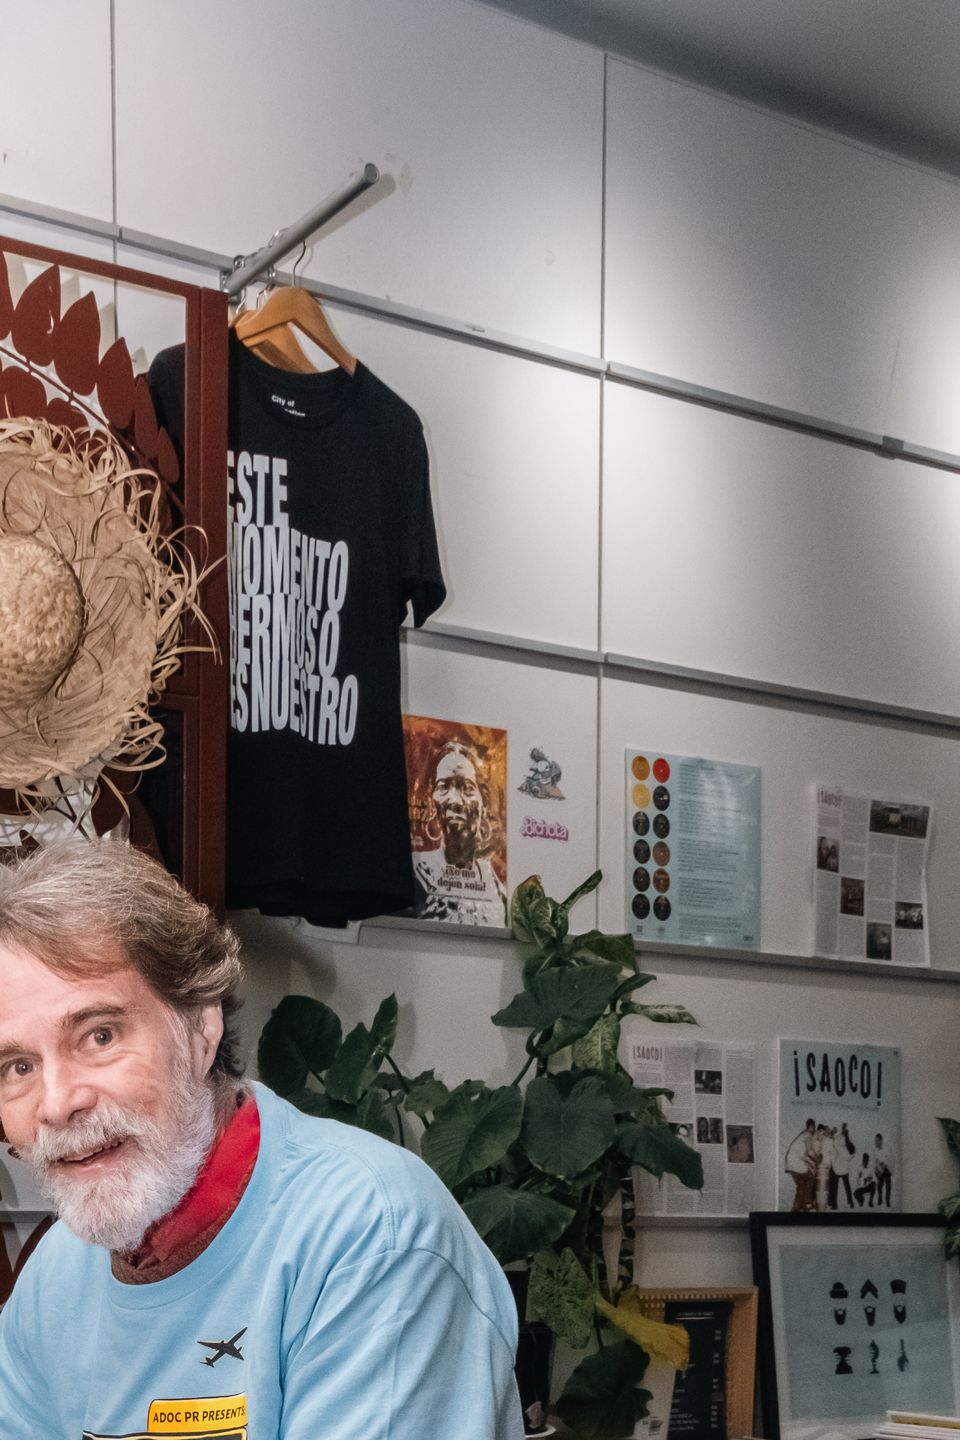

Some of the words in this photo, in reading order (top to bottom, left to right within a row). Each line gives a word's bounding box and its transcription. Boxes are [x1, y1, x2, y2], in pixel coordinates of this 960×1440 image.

[271, 395, 286, 406] City
[793, 1050, 882, 1107] ¡SAOCO!
[152, 1411, 182, 1423] ADOC
[184, 1411, 199, 1422] PR
